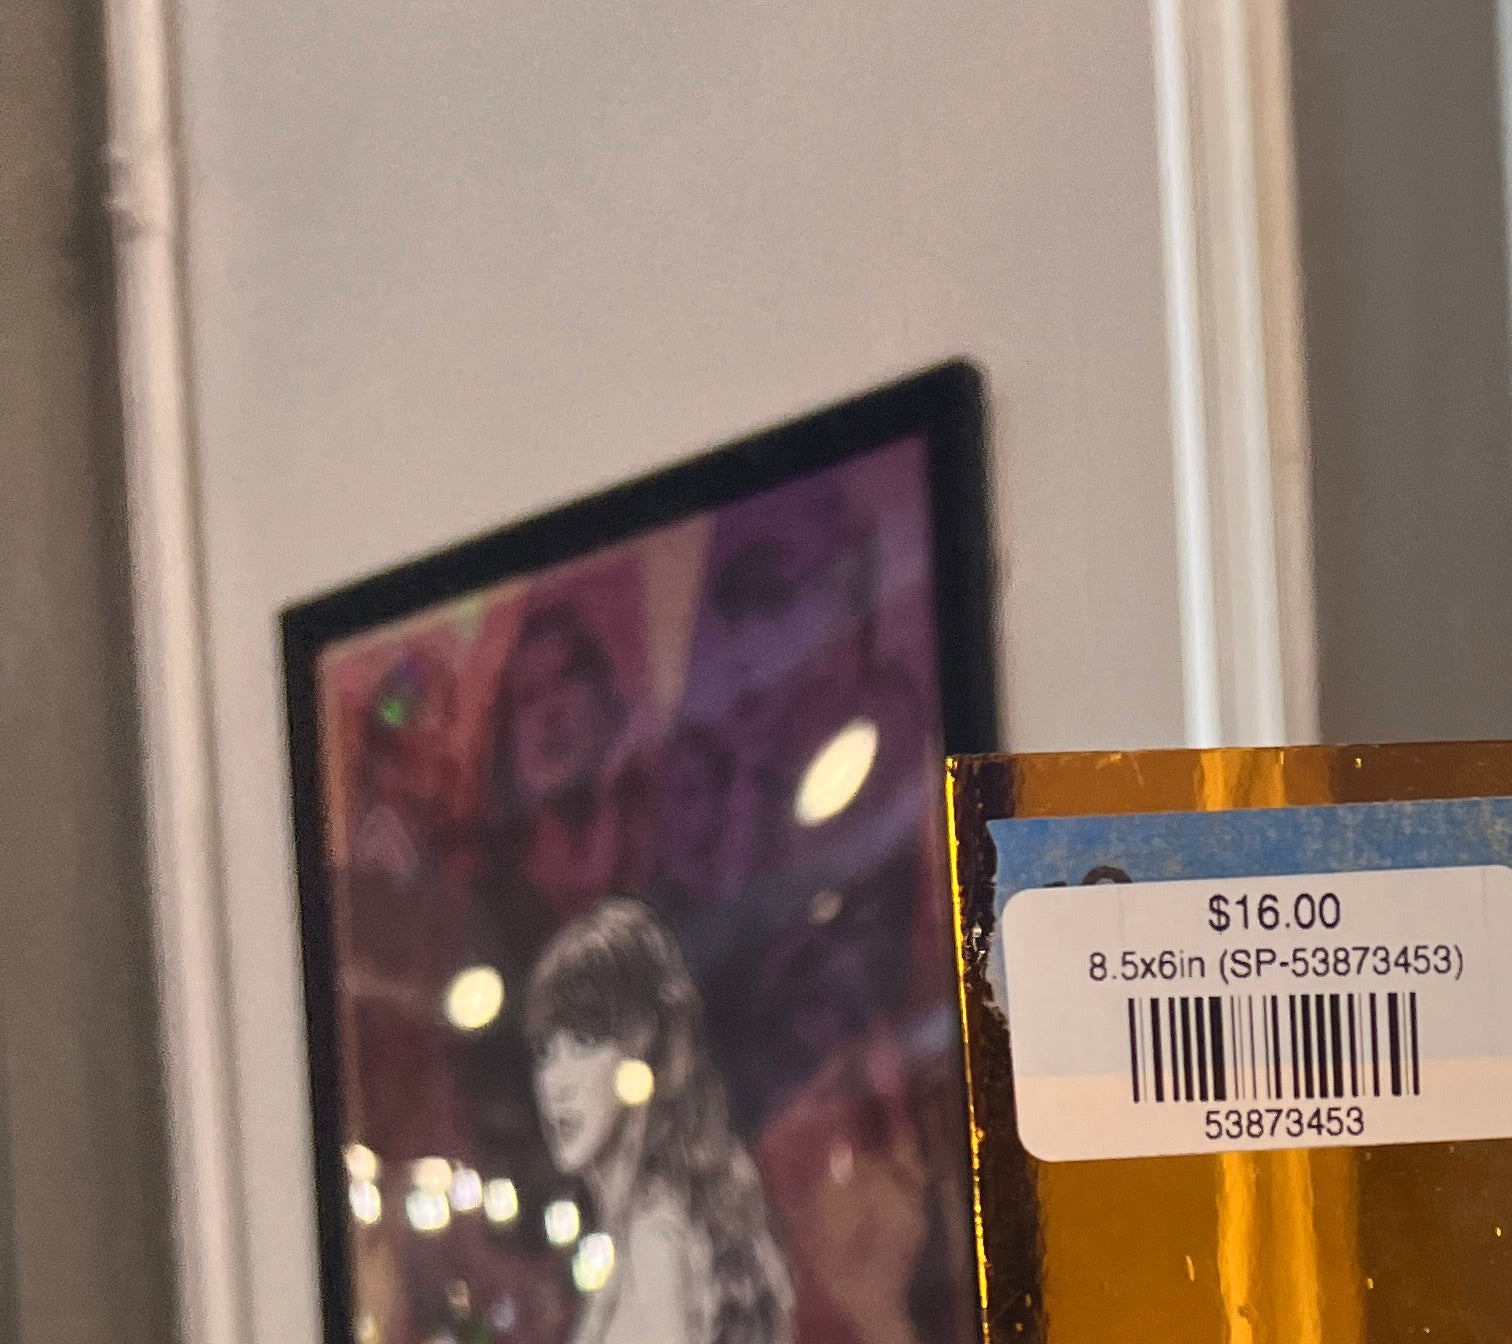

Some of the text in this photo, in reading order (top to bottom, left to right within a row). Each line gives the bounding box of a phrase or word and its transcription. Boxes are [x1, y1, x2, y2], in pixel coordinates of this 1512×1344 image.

[1208, 892, 1341, 934] $16.00
[1088, 945, 1464, 986] 8.5x6in (SP-53873453)
[1204, 1107, 1365, 1141] 53873453
